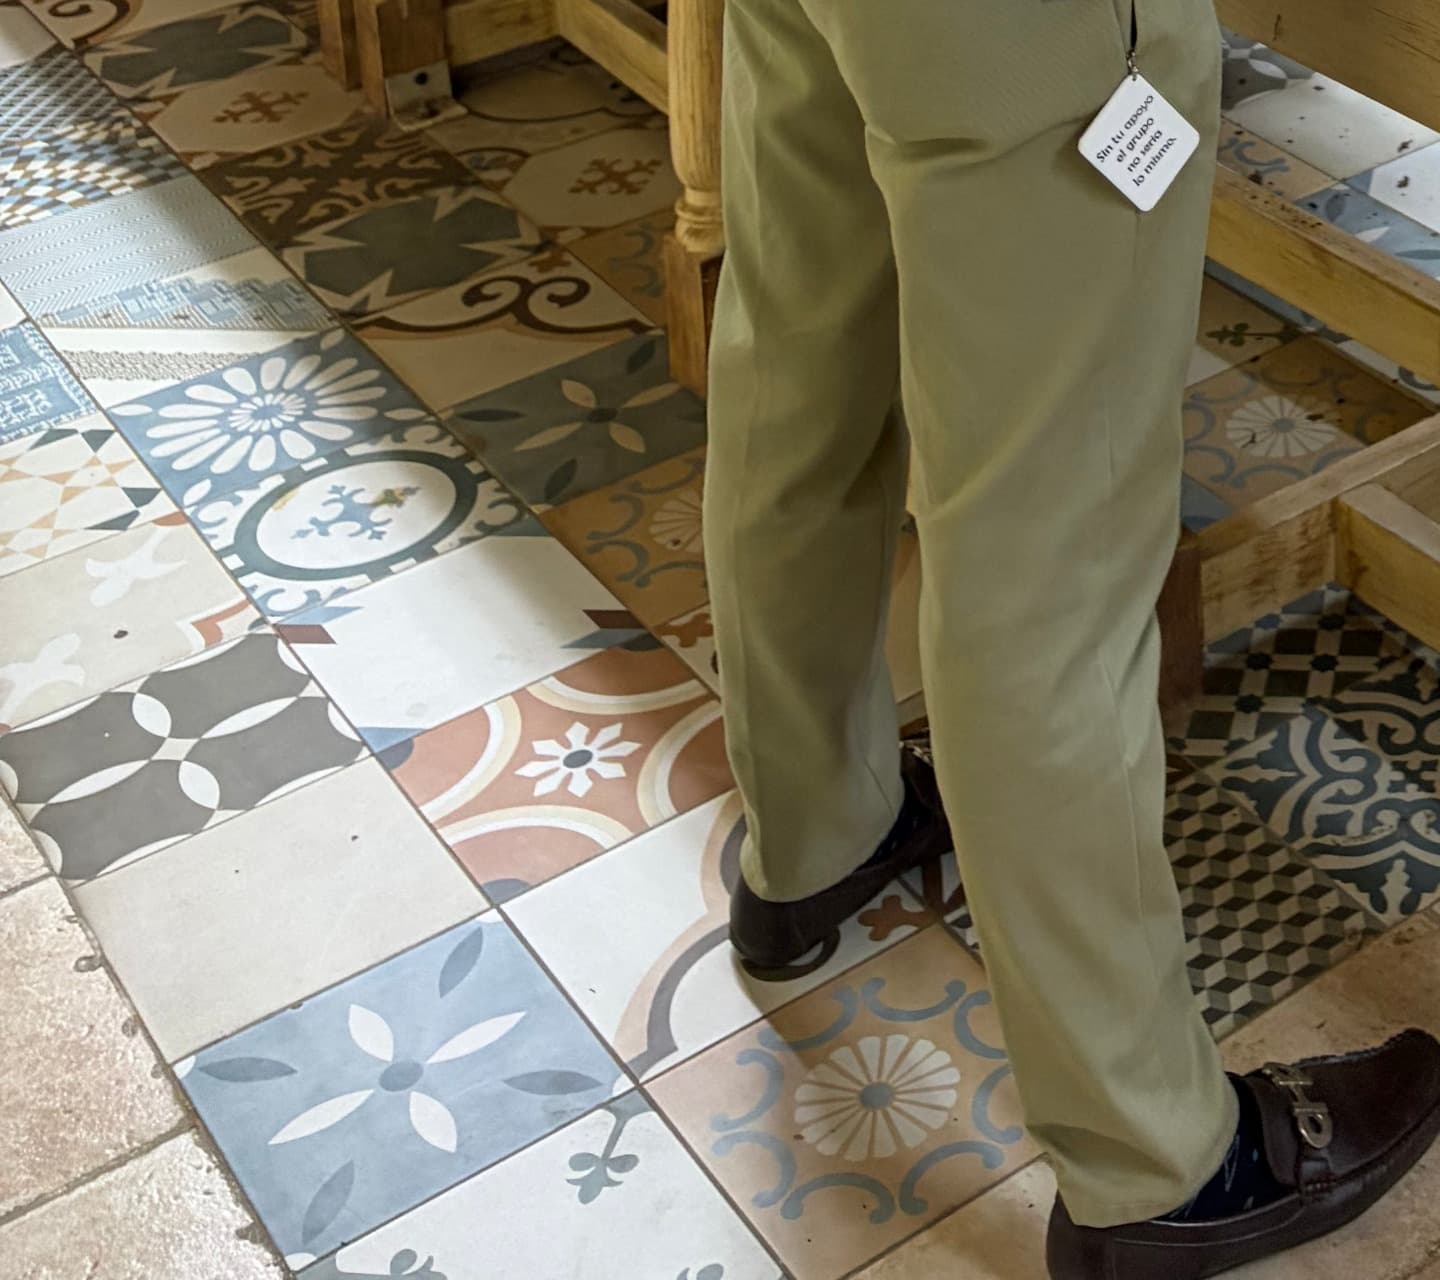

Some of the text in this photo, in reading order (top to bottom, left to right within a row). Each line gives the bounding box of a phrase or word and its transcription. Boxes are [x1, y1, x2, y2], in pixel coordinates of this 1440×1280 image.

[1096, 95, 1154, 163] Sin tu apoyo
[1116, 117, 1154, 163] el grupo
[1127, 156, 1141, 173] no
[1133, 175, 1145, 187] lo
